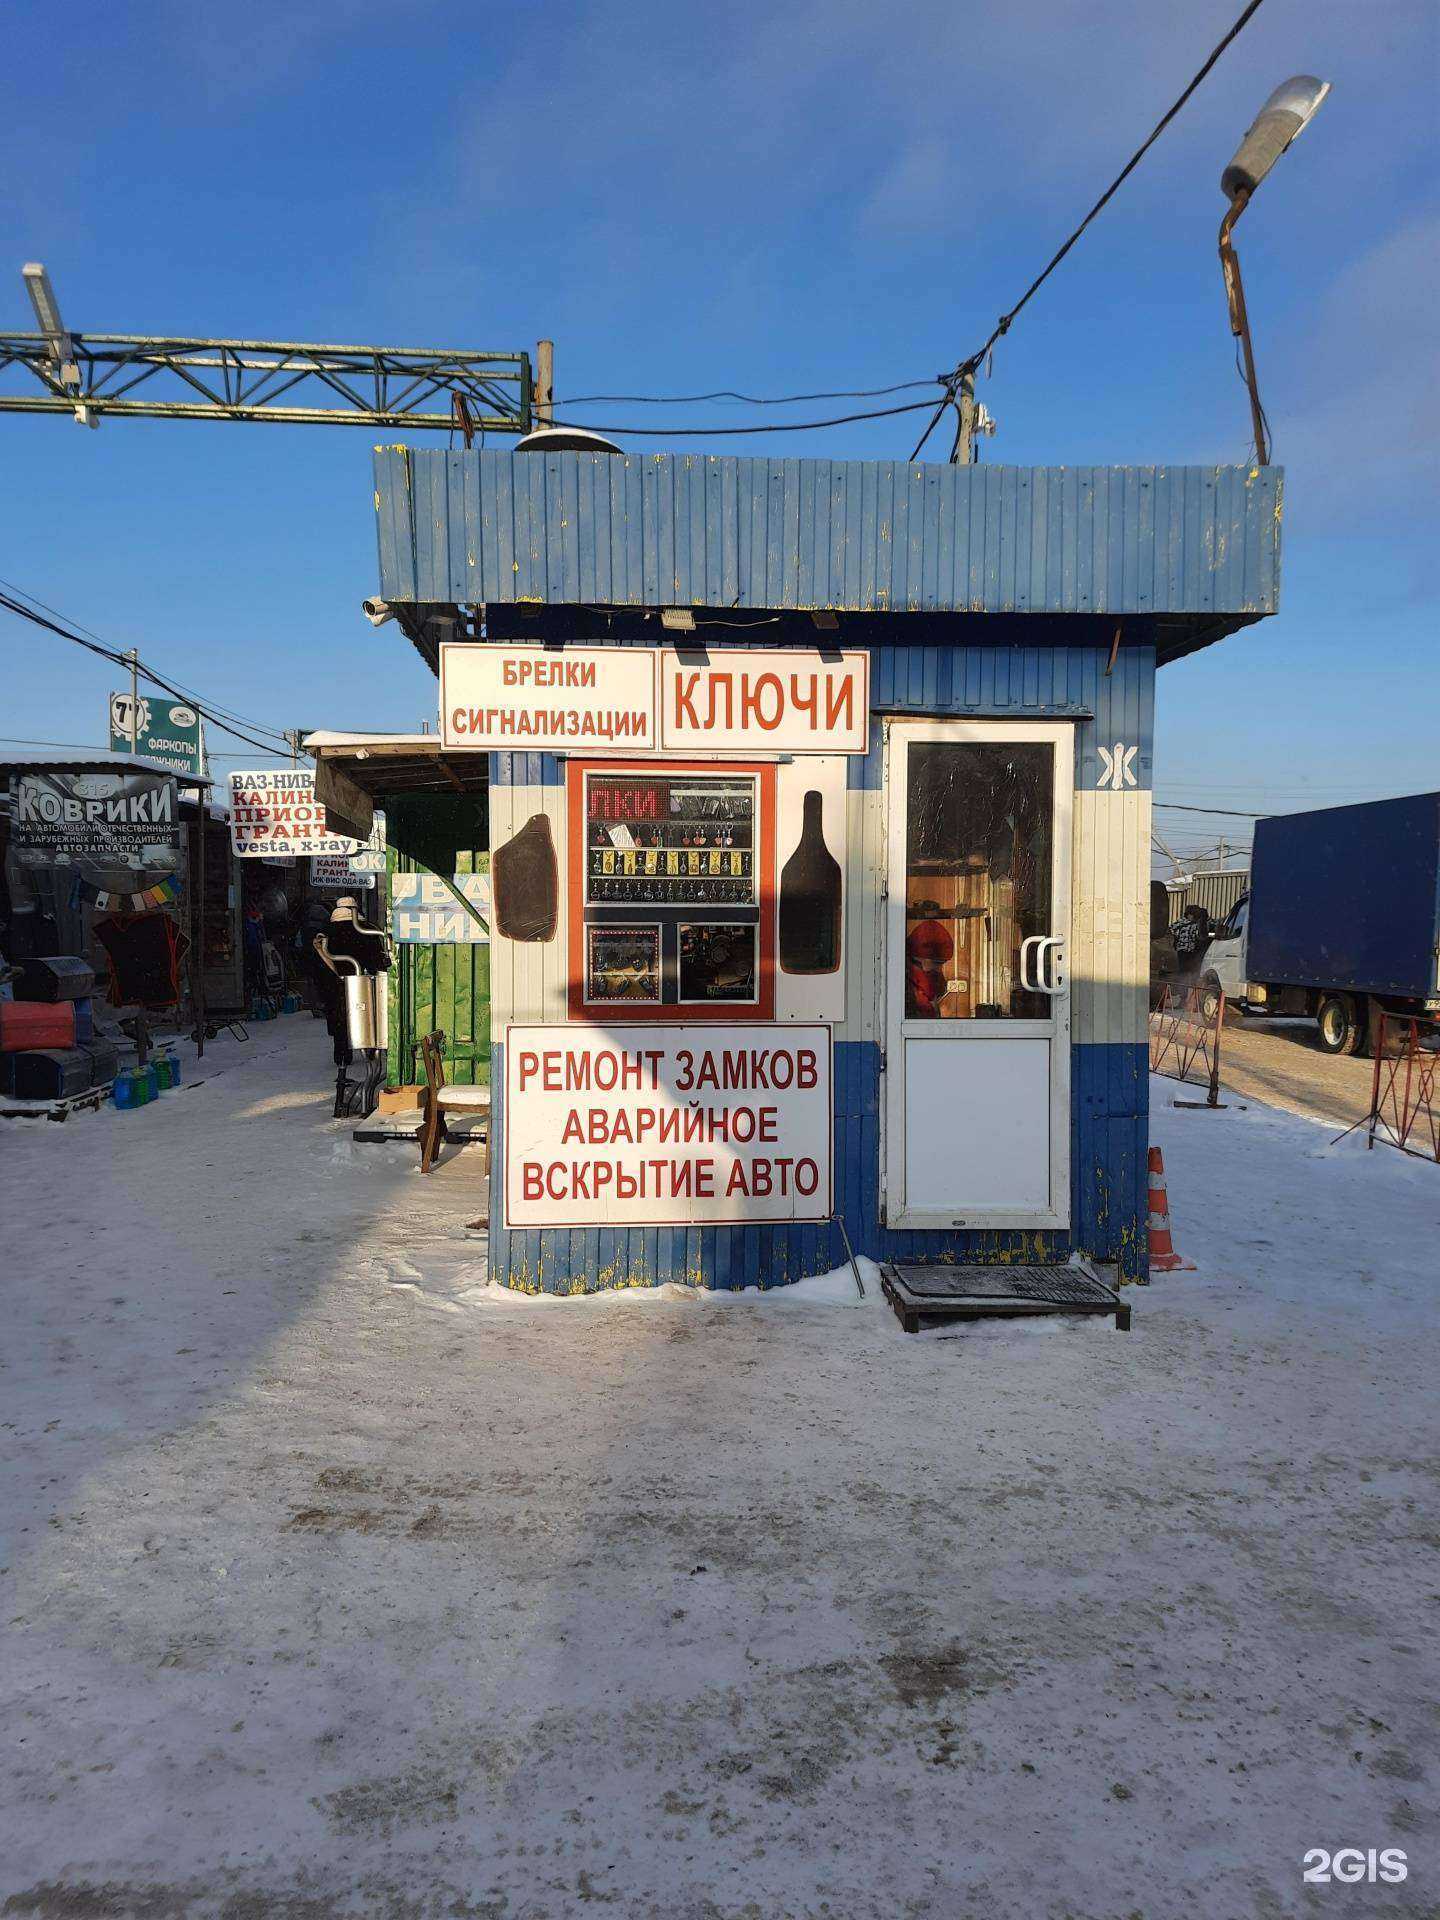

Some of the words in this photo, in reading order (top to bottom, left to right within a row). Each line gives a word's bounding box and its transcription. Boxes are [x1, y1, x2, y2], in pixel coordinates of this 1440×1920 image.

[503, 660, 596, 687] БРЕЛКИ
[675, 672, 853, 730] КЛЮЧИ
[452, 708, 647, 741] СИГНАЛИЗАЦИИ
[148, 737, 197, 755] ФАРКОПЫ
[232, 774, 315, 790] ВАЗ-НИВ
[18, 782, 172, 822] КОВРИКИ
[233, 791, 318, 806] КАЛИН
[19, 824, 32, 832] НА
[37, 824, 100, 832] АВТОМОБИЛИ
[100, 824, 172, 833] ОТЕЧЕСТВЕННЫХ
[235, 824, 341, 839] ГРАНТ
[19, 835, 26, 843] И
[30, 835, 90, 843] ЗАРУБЕЖНЫХ
[93, 834, 173, 844] ПРОИЗВОДИТЕЛЕЙ
[55, 844, 139, 852] АВТОЗАПЧАСТИ
[236, 841, 296, 854] vesta,
[301, 840, 351, 854] x-ray
[519, 1050, 665, 1091] РЕМОНТ
[675, 1049, 819, 1090] ЗАМКОВ
[561, 1100, 779, 1144] АВАРИЙНОЕ
[523, 1159, 715, 1201] ВСКРЫТИЕ
[725, 1157, 819, 1197] АВТО
